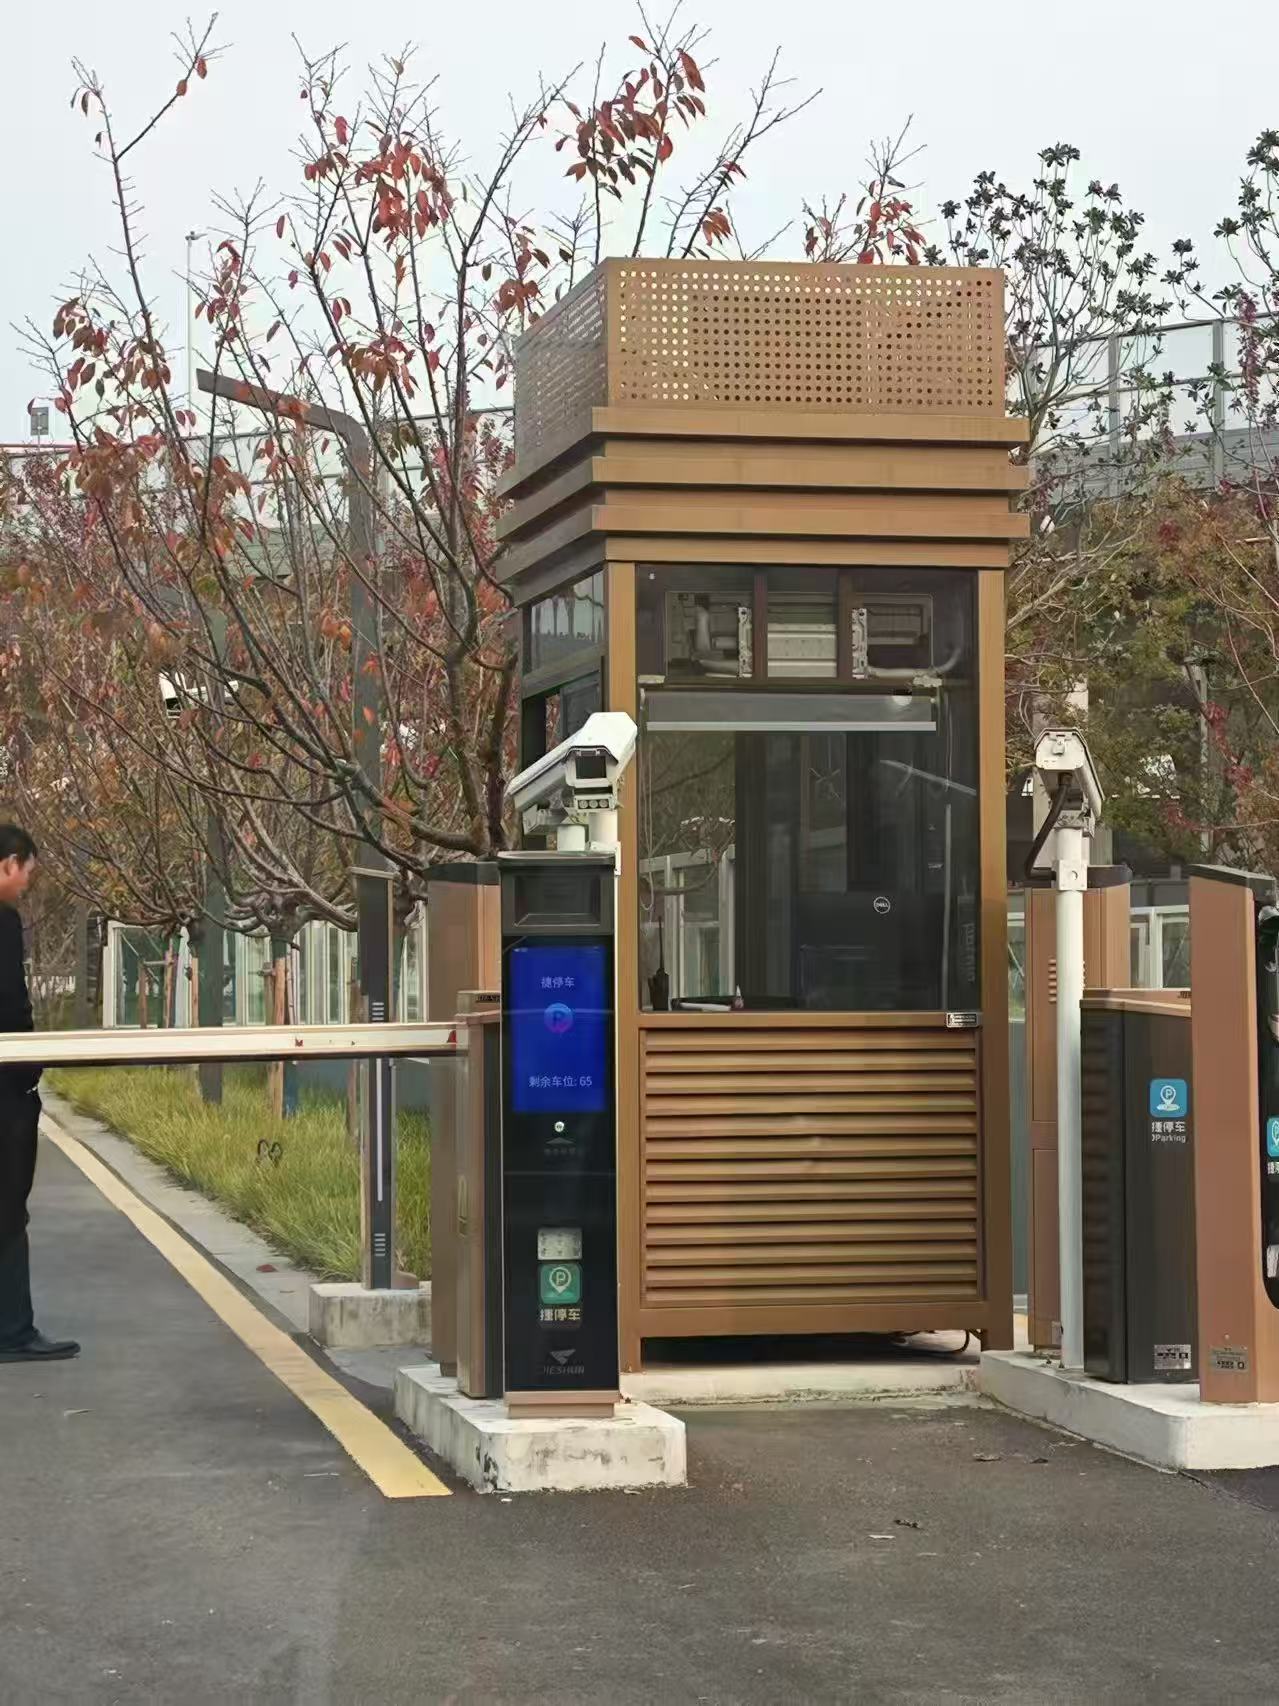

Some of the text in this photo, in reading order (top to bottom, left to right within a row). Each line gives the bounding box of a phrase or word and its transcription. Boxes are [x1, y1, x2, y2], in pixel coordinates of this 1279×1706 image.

[541, 976, 575, 988] 捷停车
[579, 1076, 593, 1087] 65
[1151, 1121, 1186, 1133] 捷停车
[540, 1308, 581, 1321] 捷停车
